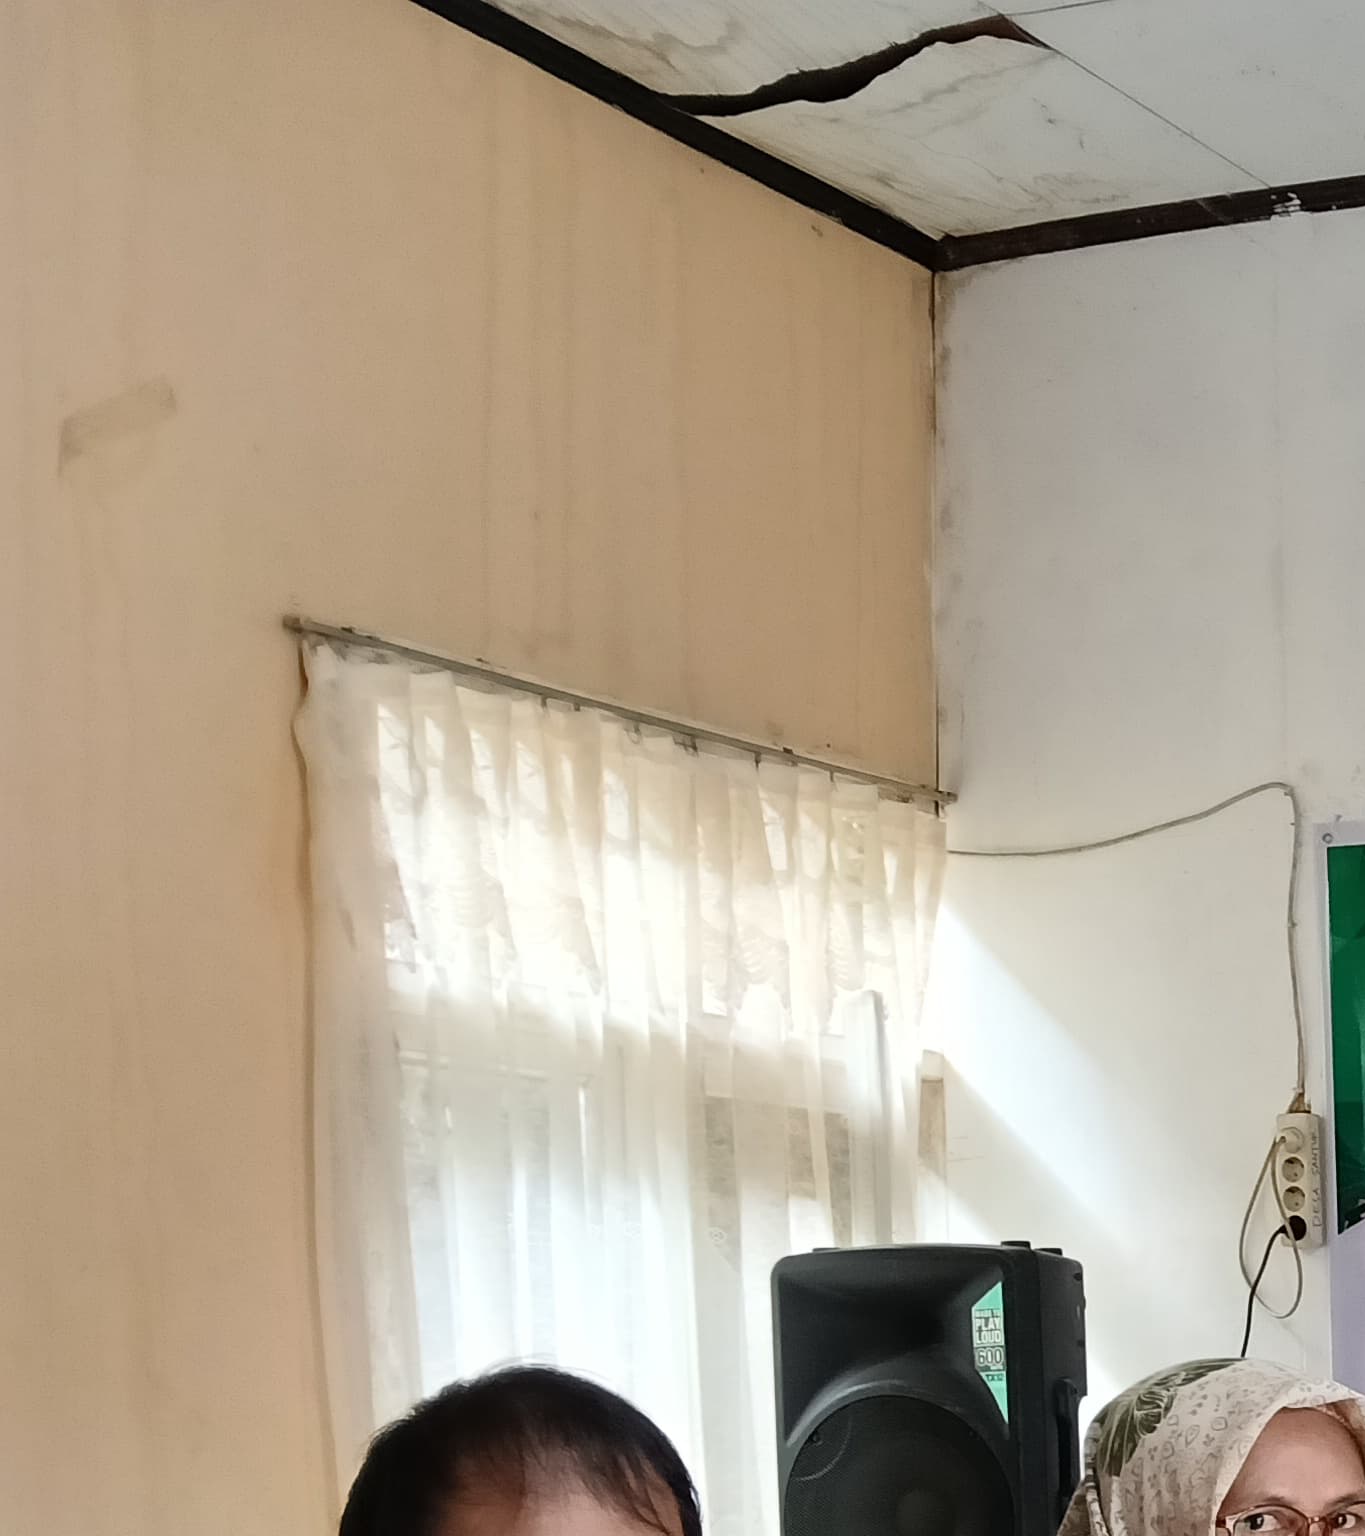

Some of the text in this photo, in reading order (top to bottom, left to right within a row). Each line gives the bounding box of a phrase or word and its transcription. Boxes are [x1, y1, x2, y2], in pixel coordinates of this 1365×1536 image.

[975, 1317, 1001, 1330] PLAY
[975, 1330, 1001, 1344] LOUD
[977, 1347, 1003, 1366] 600
